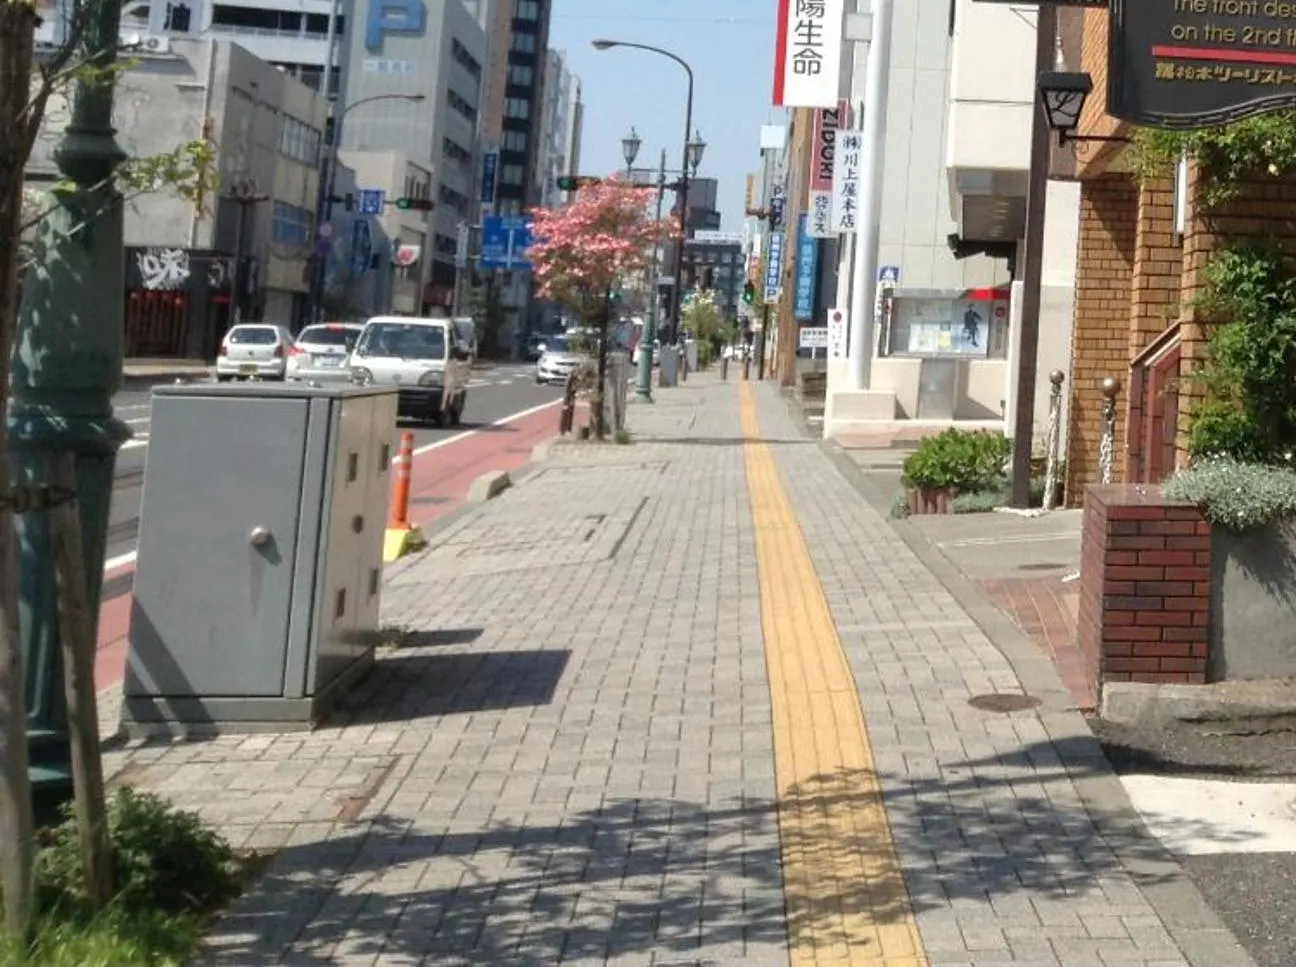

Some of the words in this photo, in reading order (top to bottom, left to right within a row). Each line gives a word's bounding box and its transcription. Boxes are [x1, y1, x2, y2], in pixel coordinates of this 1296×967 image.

[1171, 24, 1198, 41] on
[1204, 24, 1236, 43] the
[1242, 26, 1282, 46] 2nd
